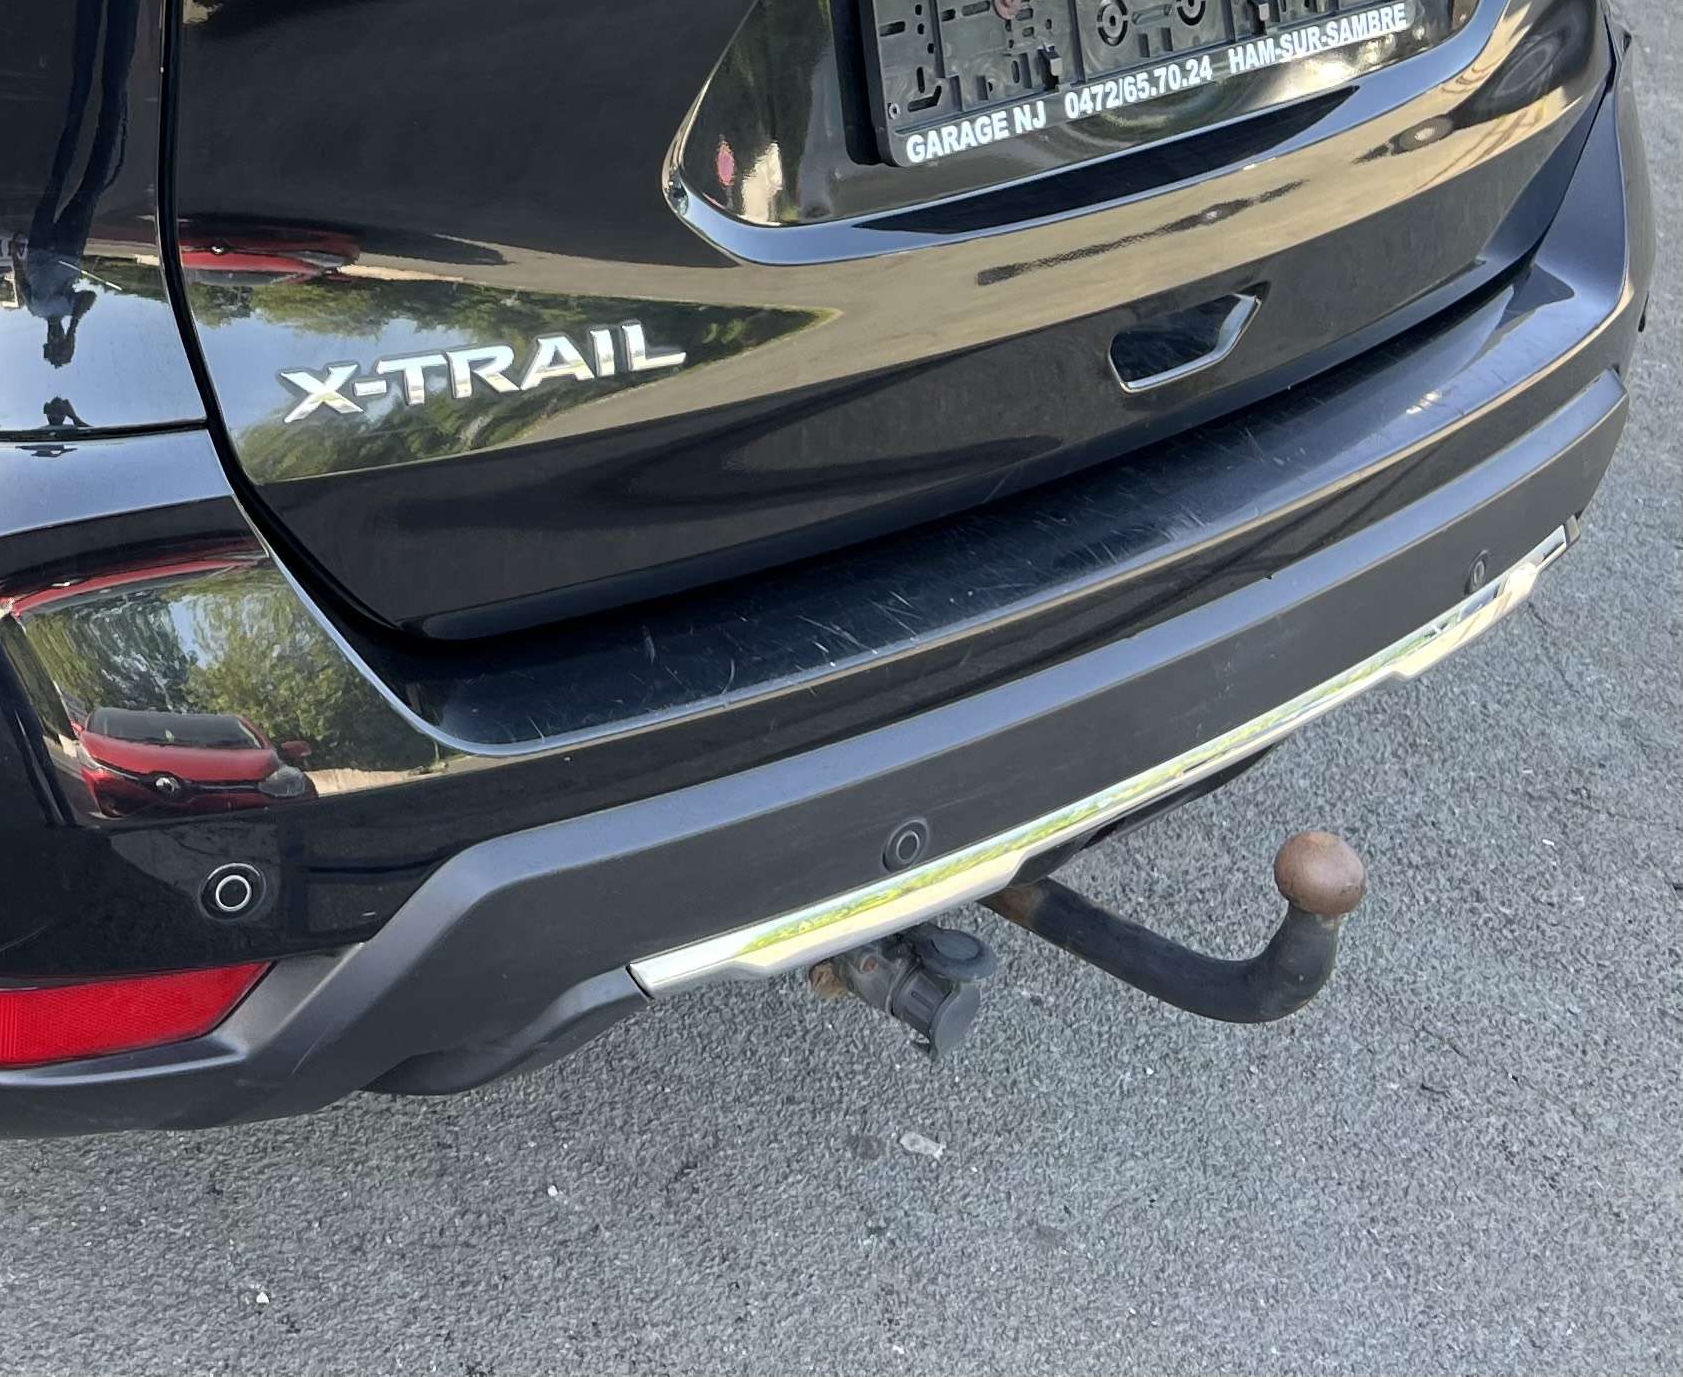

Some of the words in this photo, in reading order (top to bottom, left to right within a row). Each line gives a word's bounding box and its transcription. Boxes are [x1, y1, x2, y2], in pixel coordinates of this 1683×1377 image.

[906, 110, 1010, 163] GARAGE
[1013, 100, 1047, 134] NJ
[1064, 55, 1213, 119] 0472/65.70.24
[1228, 3, 1407, 73] HAM-SUR-SAMBRE
[279, 319, 688, 423] X-TRAIL
